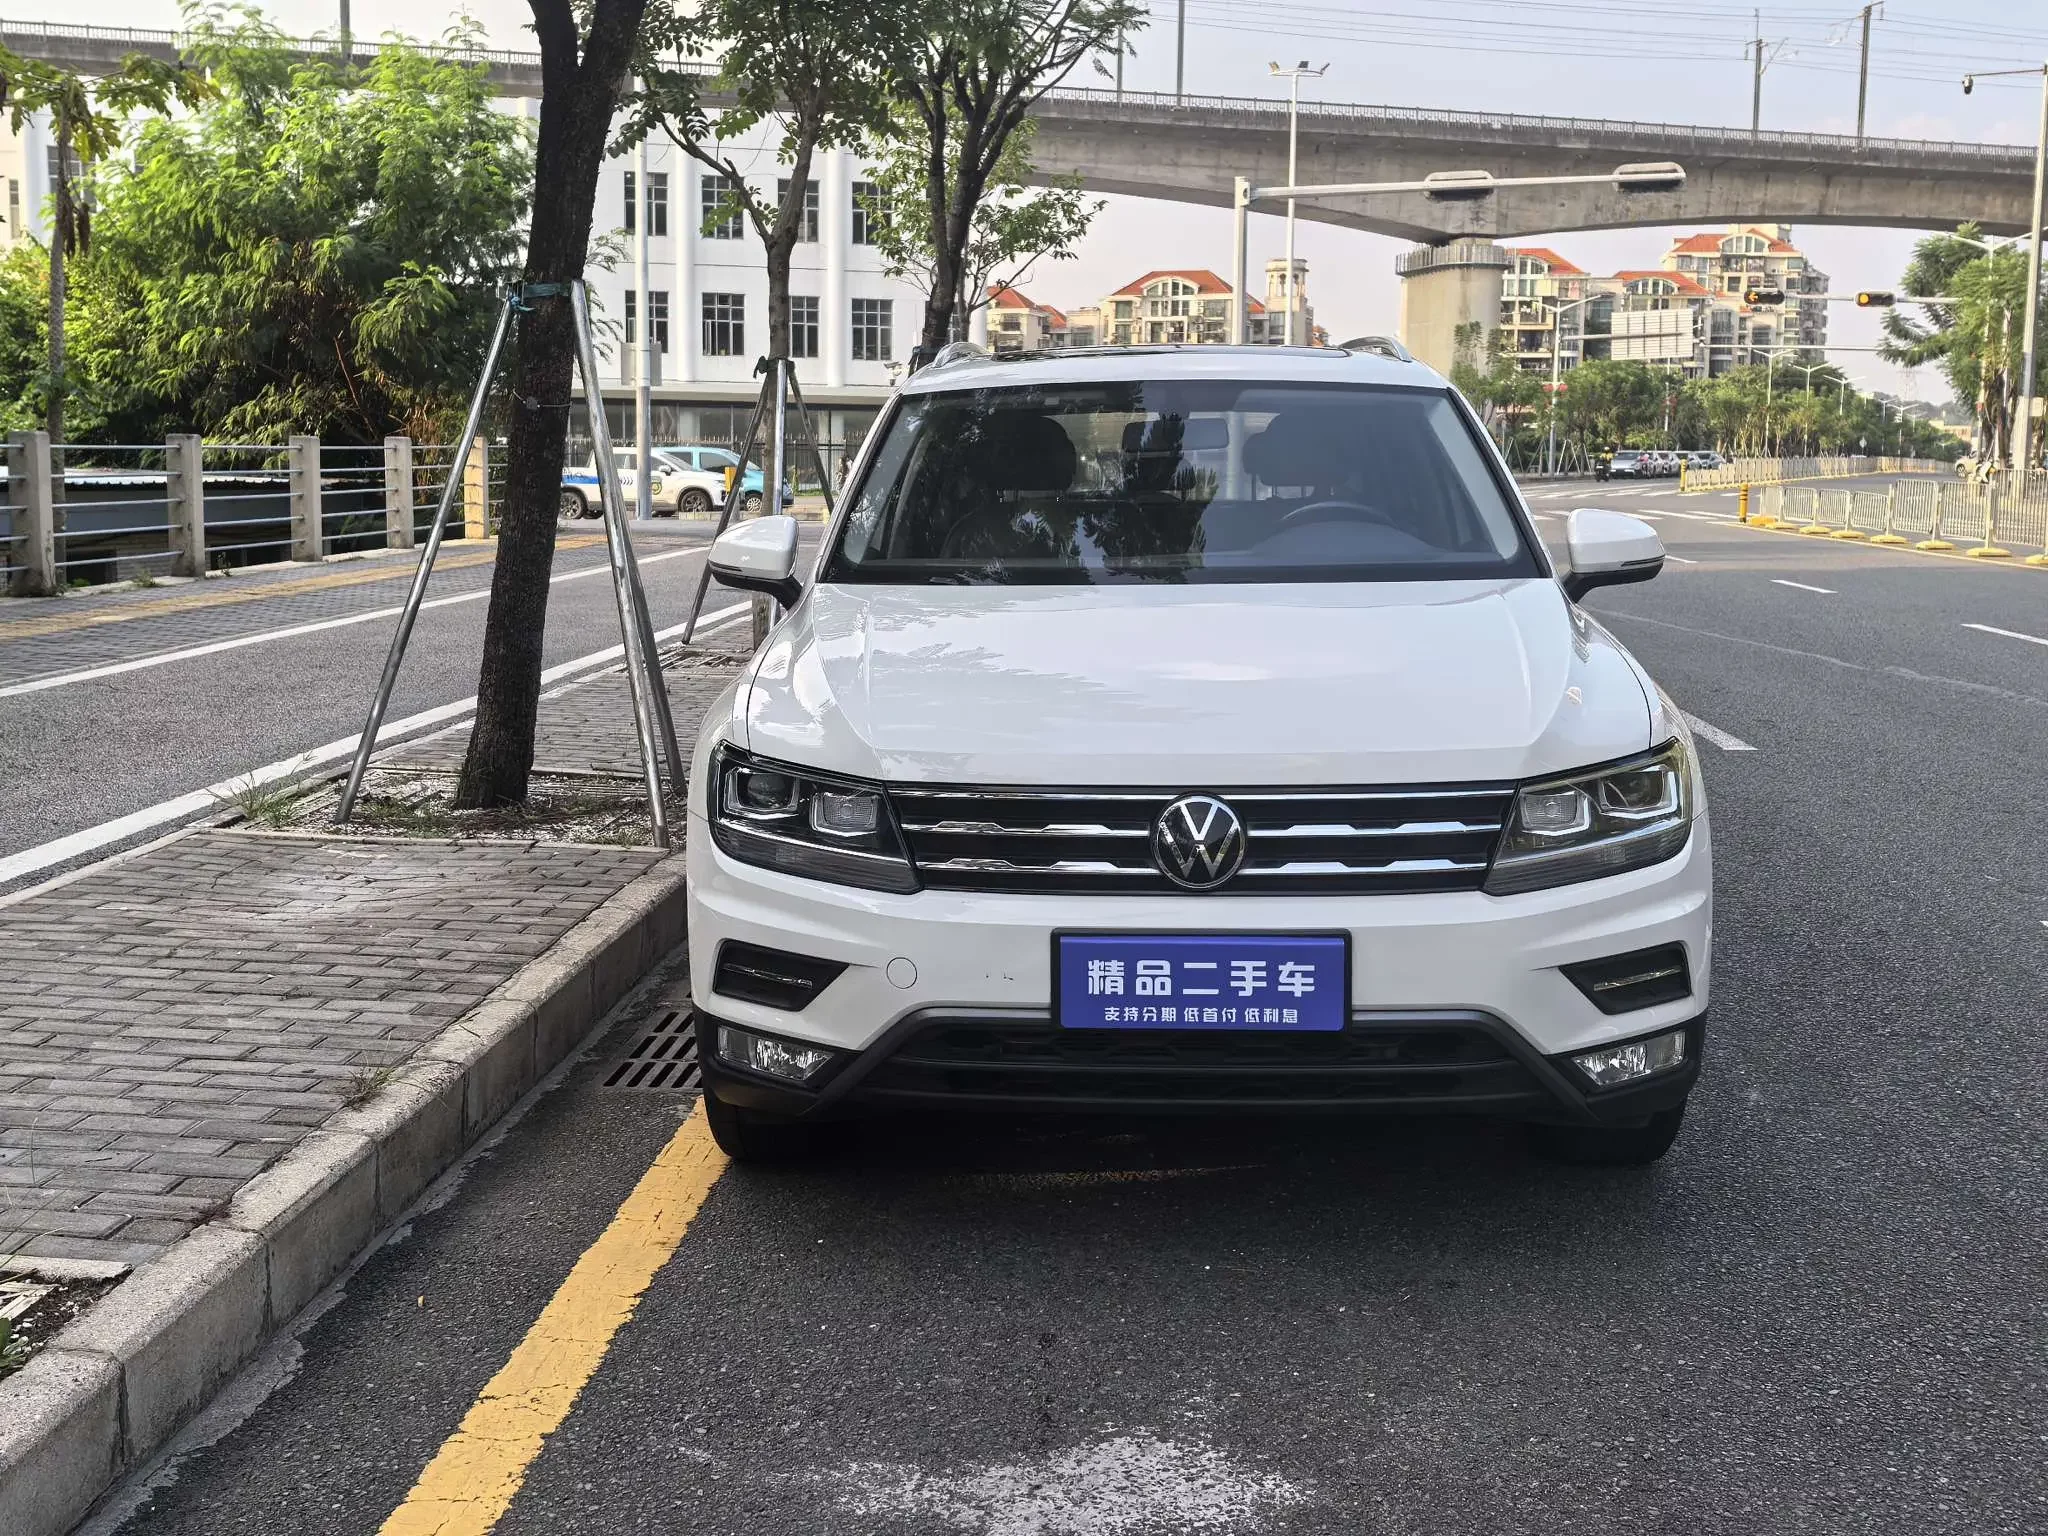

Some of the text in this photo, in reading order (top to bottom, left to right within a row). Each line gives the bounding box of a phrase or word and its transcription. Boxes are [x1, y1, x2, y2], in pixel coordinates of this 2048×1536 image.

[1087, 959, 1315, 997] 精品二手车
[1104, 1006, 1298, 1024] 支持分期 低首付 低利息
